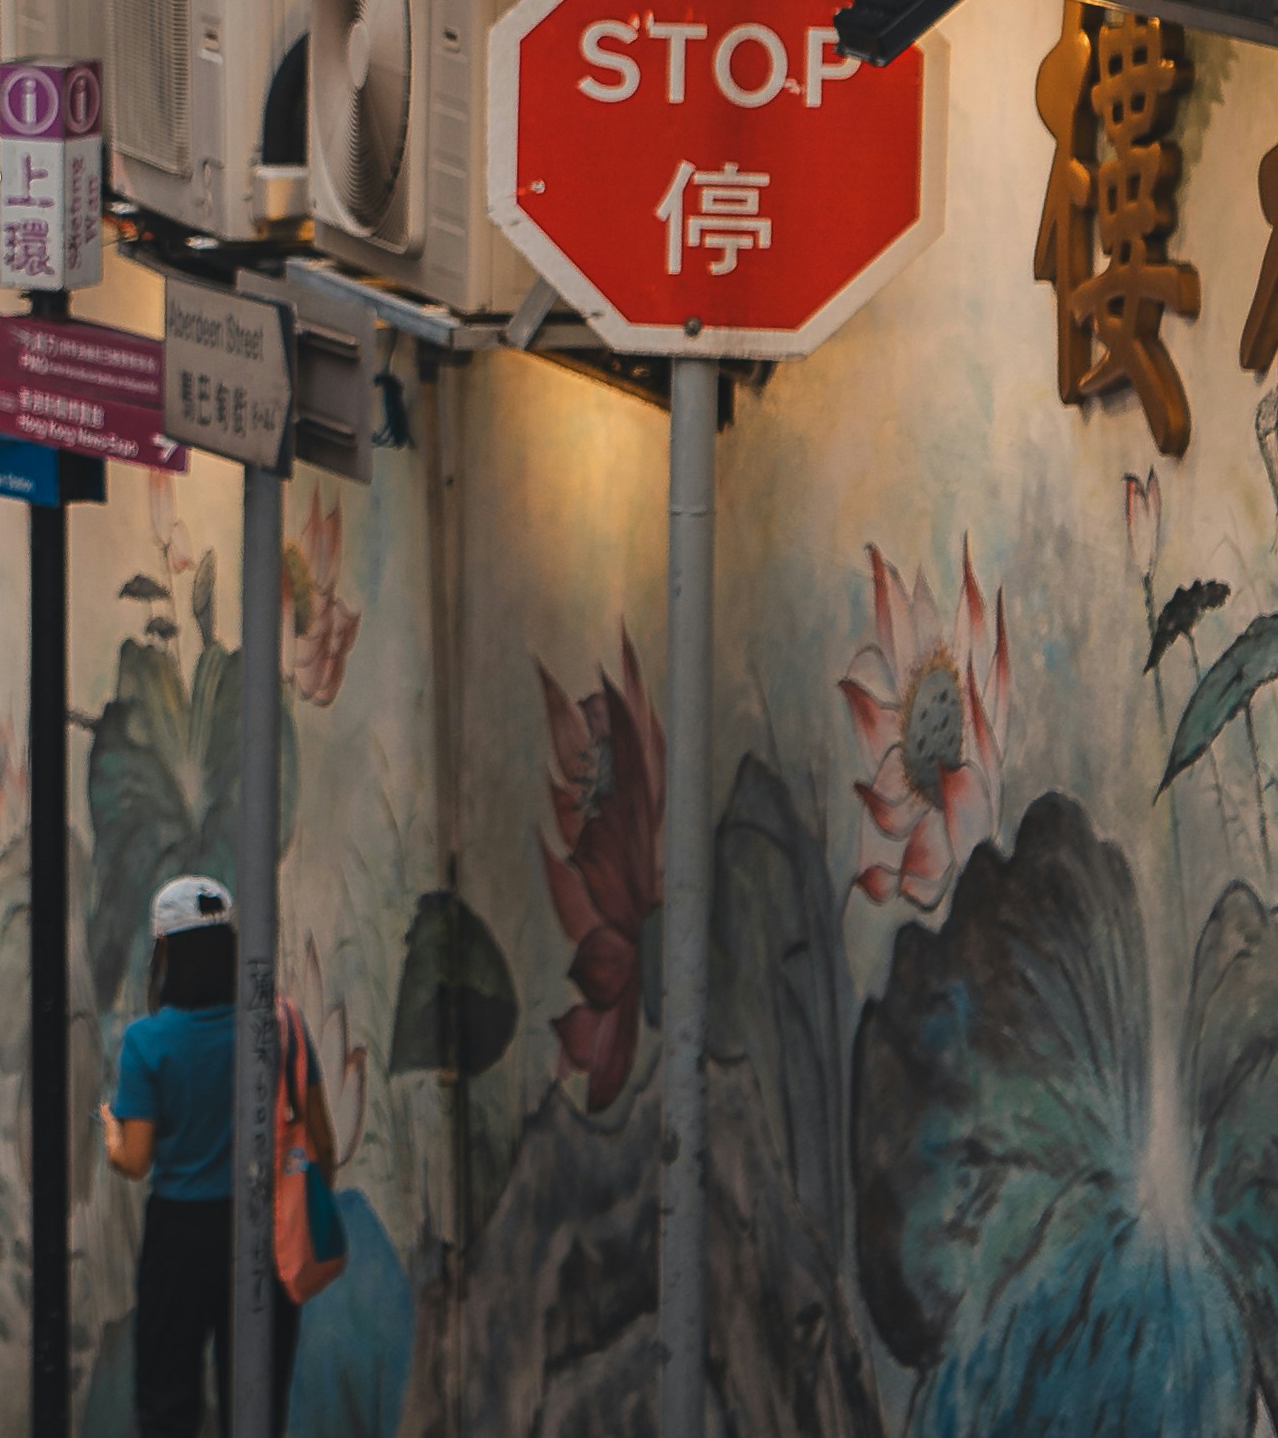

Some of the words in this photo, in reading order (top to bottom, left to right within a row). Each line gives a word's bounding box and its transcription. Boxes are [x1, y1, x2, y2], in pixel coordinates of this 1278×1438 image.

[576, 18, 861, 108] STOP
[4, 154, 56, 276] 上環
[654, 159, 772, 275] 停
[225, 311, 264, 361] Street
